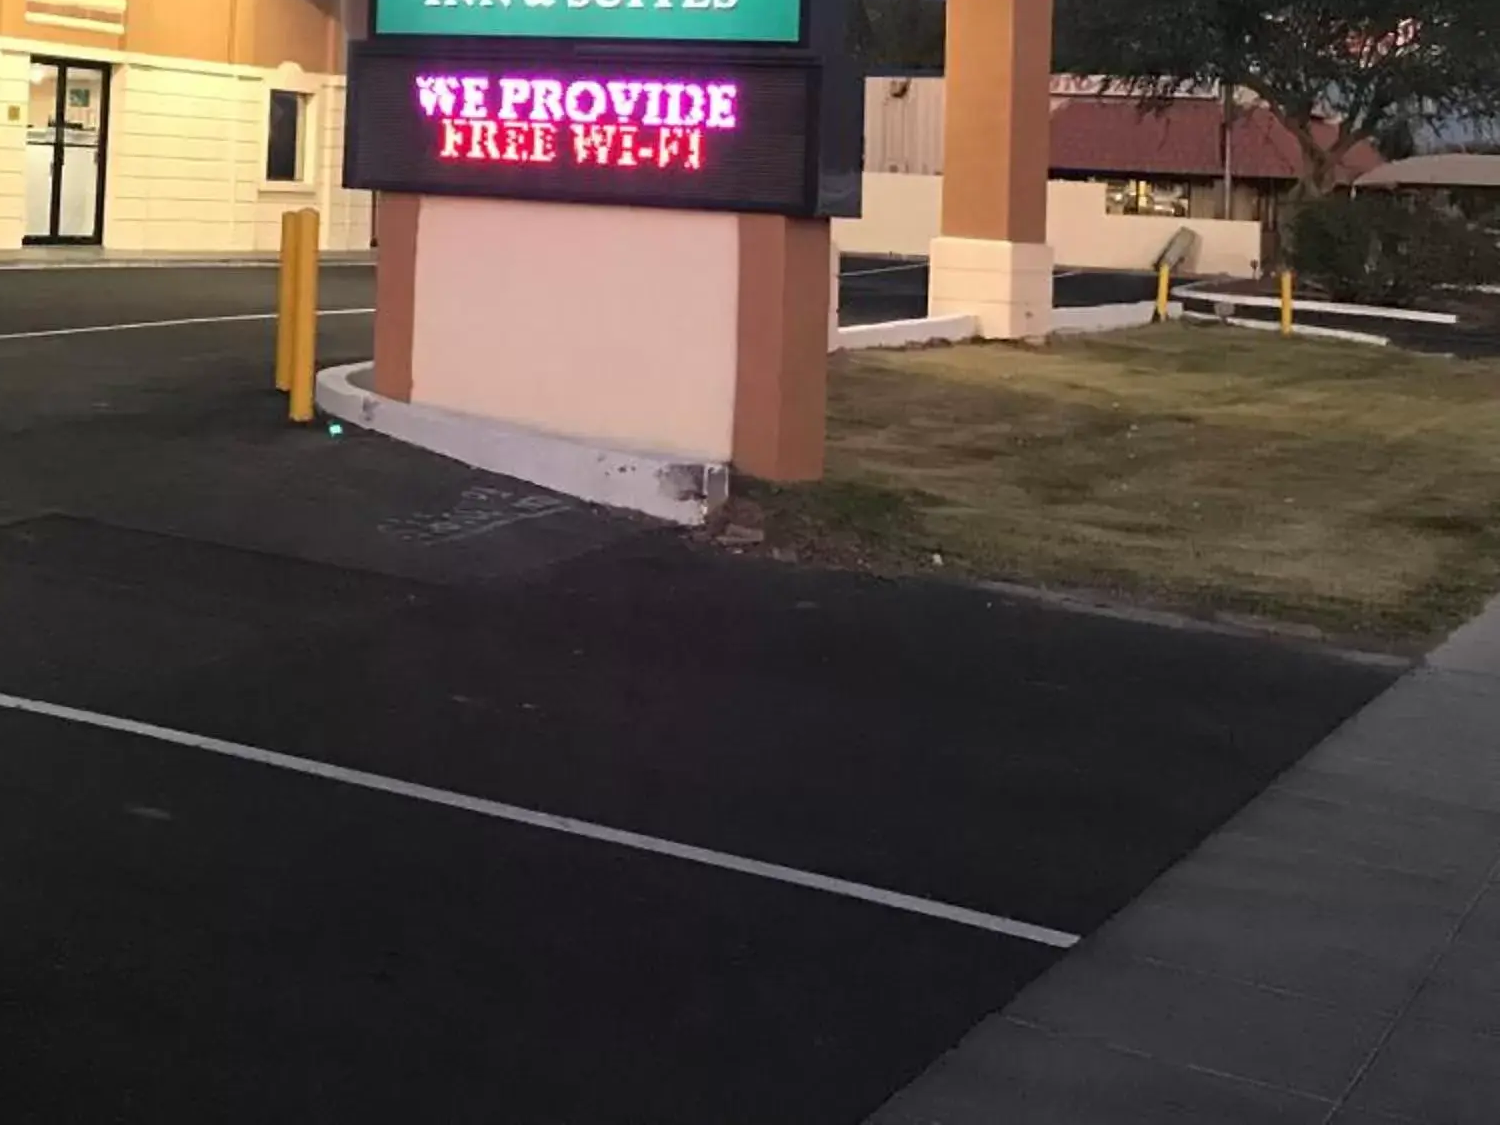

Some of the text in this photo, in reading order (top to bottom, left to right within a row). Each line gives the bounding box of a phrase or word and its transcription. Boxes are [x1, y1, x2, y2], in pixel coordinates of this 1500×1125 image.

[416, 76, 737, 128] WE PROVIDE
[440, 119, 557, 163] FREE
